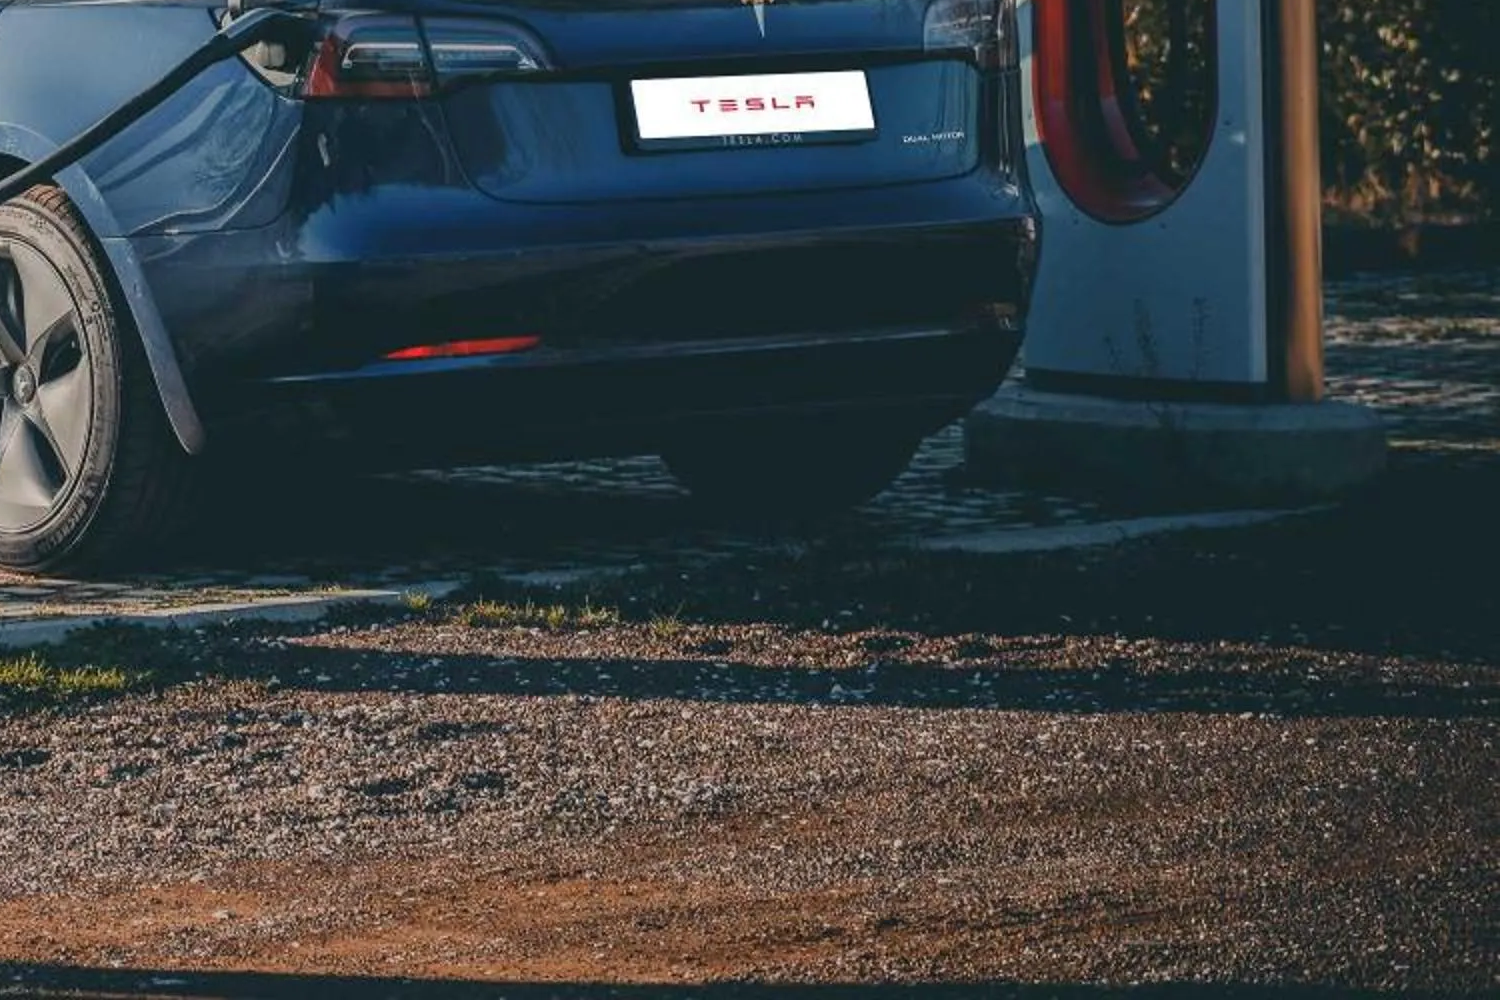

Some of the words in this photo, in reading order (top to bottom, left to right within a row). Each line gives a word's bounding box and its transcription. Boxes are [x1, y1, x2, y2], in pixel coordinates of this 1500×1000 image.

[690, 95, 816, 113] TESLA
[902, 135, 928, 143] DUAL
[931, 131, 965, 140] MOTOR
